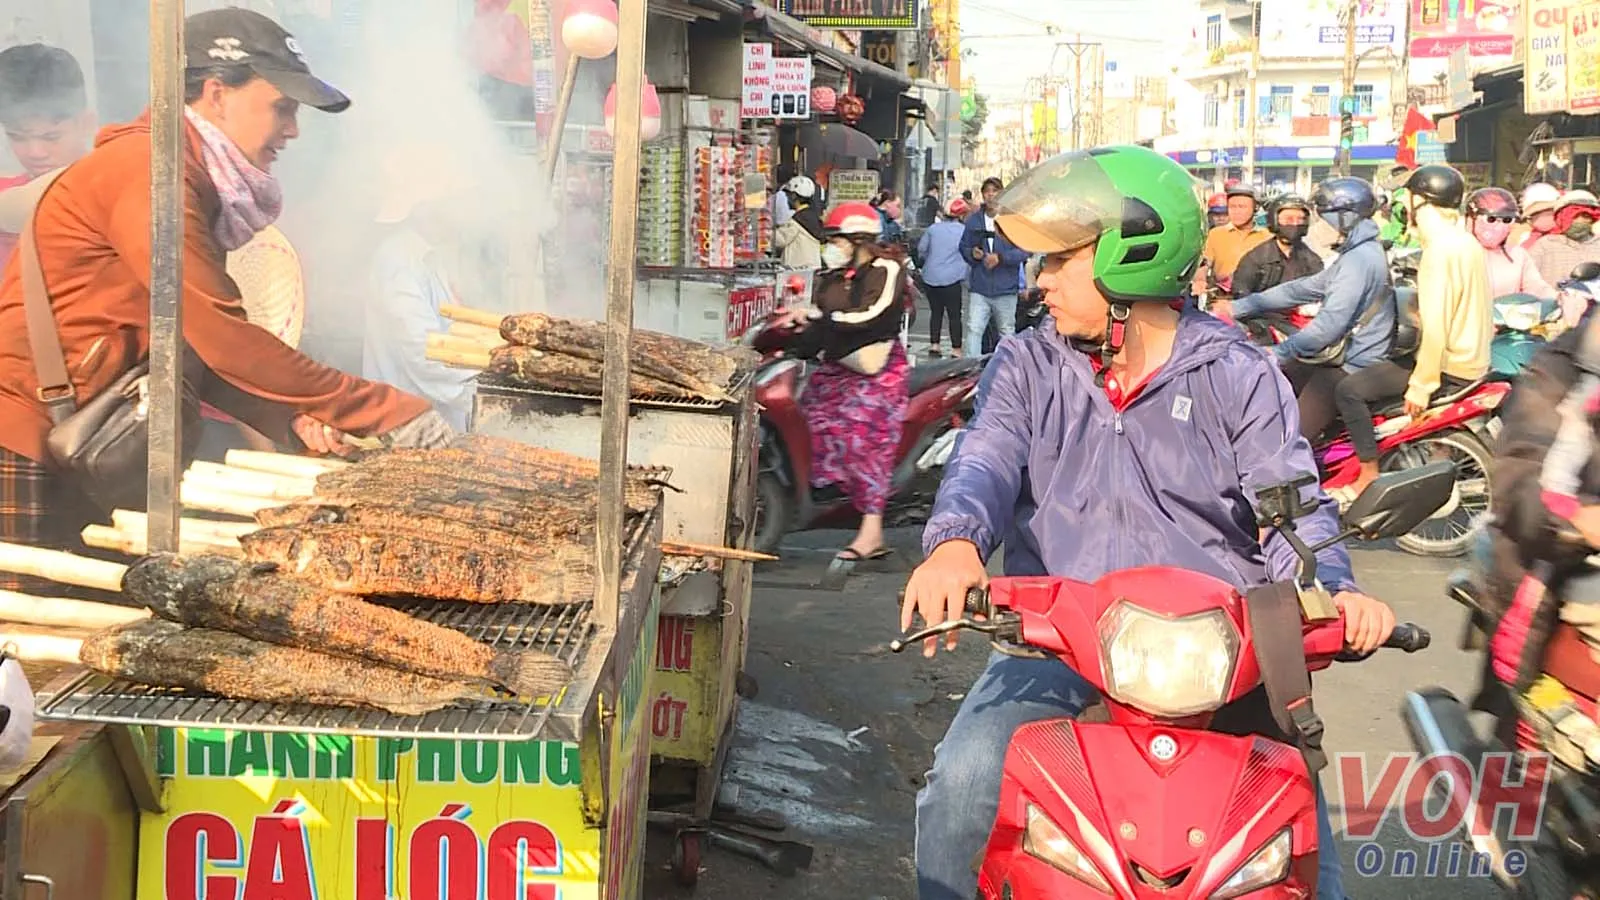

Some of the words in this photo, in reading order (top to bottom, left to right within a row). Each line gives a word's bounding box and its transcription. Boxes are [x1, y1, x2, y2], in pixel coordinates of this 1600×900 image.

[748, 61, 766, 70] LINH
[744, 75, 769, 86] KHÔNG
[166, 800, 317, 900] CÁ
